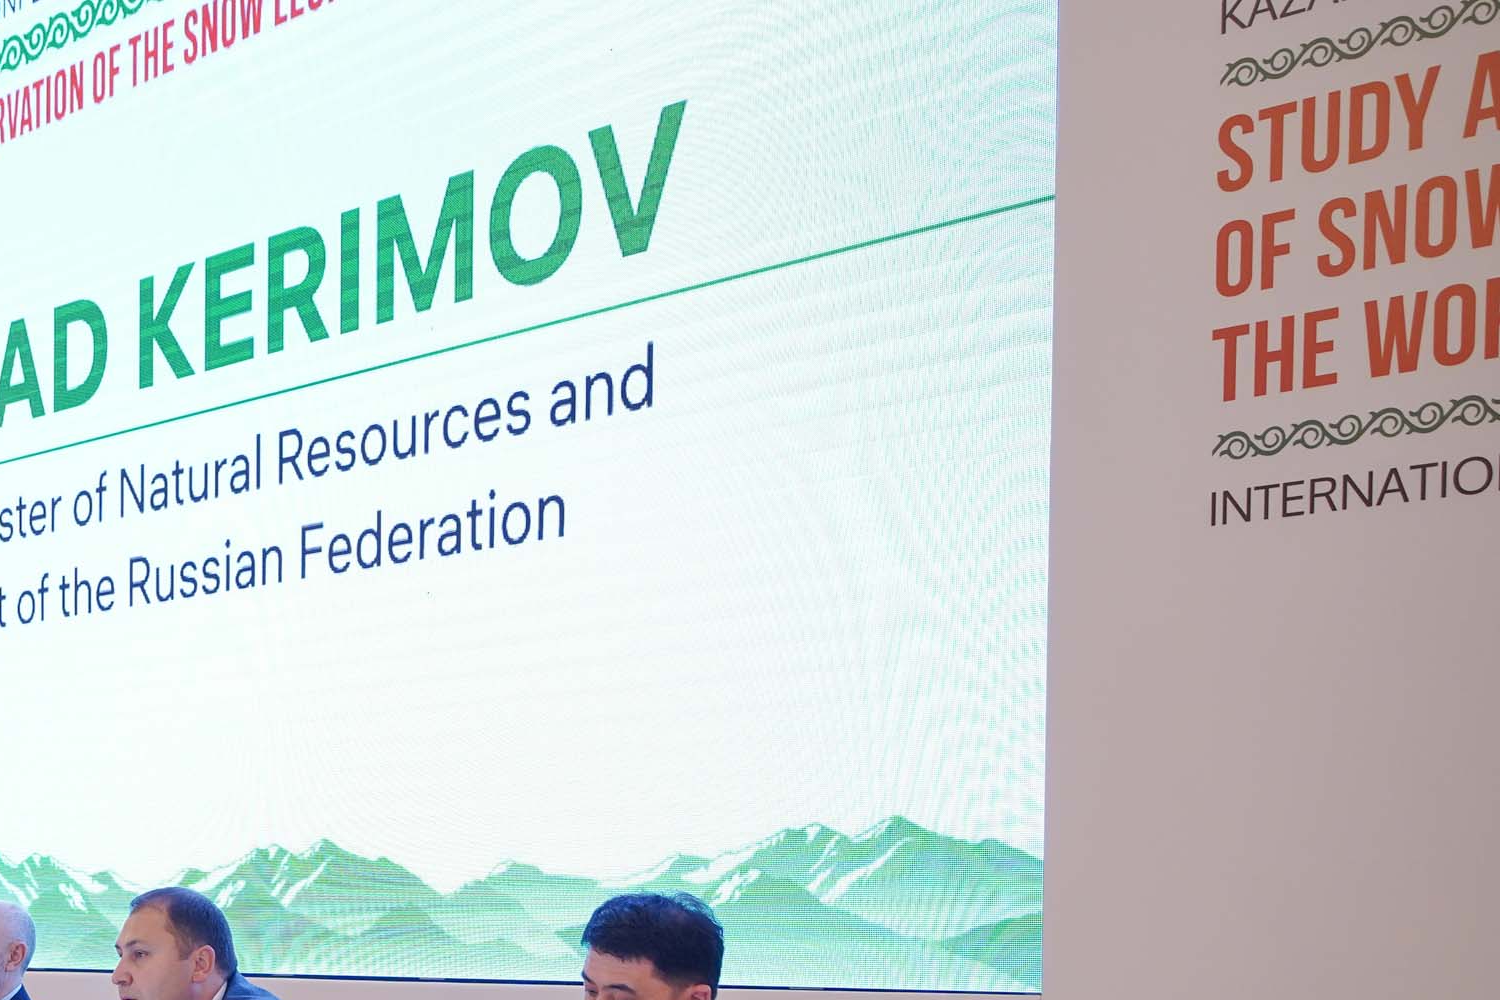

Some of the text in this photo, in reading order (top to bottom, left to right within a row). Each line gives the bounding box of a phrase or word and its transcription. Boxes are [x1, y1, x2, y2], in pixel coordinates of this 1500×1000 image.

[92, 44, 122, 105] OF
[128, 19, 176, 88] THE
[183, 0, 263, 65] SNOW
[1216, 65, 1442, 193] STUDY
[138, 100, 689, 390] KERIMOV
[1215, 207, 1296, 298] OF
[1211, 307, 1340, 403] THE
[72, 469, 108, 528] of
[119, 432, 262, 519] Natural
[278, 390, 532, 486] Resources
[549, 341, 655, 428] and
[1210, 455, 1500, 527] INTERNATIO
[16, 571, 50, 626] of
[58, 567, 116, 618] the
[128, 539, 283, 608] Russian
[300, 489, 566, 580] Federation
